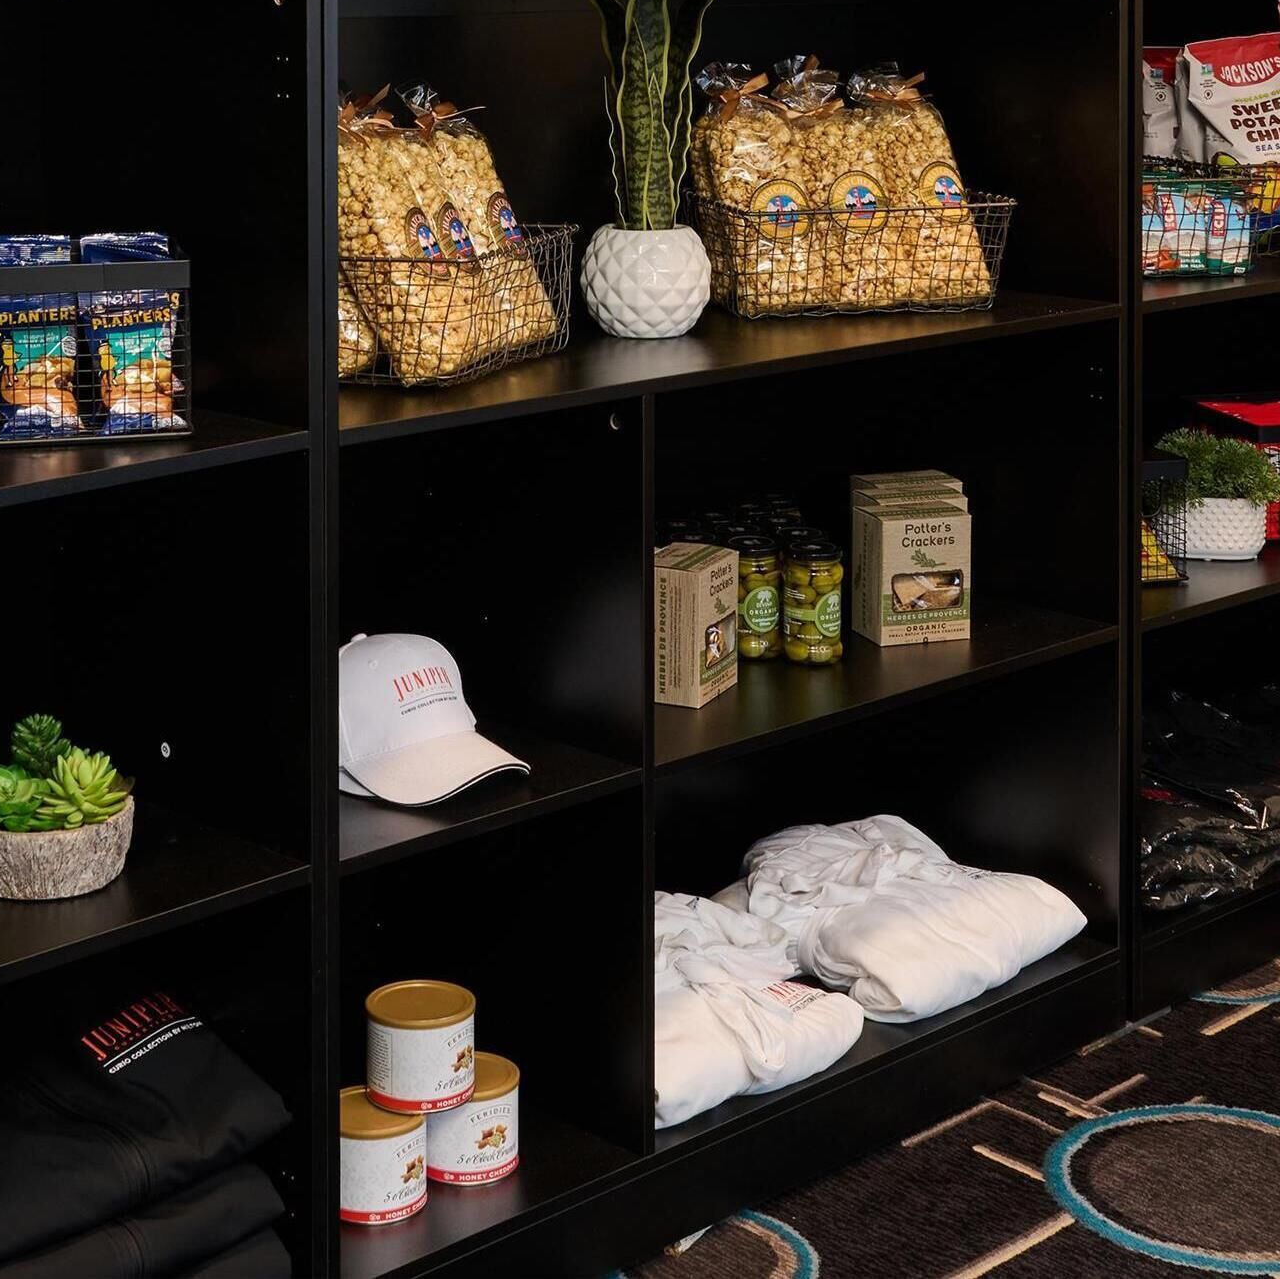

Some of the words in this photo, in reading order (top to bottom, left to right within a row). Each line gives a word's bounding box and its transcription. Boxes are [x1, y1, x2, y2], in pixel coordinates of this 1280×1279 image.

[1255, 143, 1273, 152] SEA
[91, 307, 172, 331] PLANTERS
[905, 521, 952, 535] Potter's
[901, 535, 956, 548] Crackers
[710, 563, 733, 584] Potter's
[709, 575, 734, 597] Crackers
[659, 576, 668, 637] PROVENCE
[887, 613, 916, 621] HERBES
[917, 612, 927, 620] DE
[929, 609, 968, 619] PROVENCE
[905, 622, 947, 633] ORGANIC
[392, 666, 453, 703] JUNIPER
[81, 992, 188, 1061] JUNIPER
[108, 1058, 132, 1074] CURIO
[131, 1032, 174, 1060] COLLECTION
[436, 1096, 459, 1109] HONEY
[469, 1107, 512, 1124] FERIDIES
[458, 1171, 488, 1182] HONEY
[385, 1205, 412, 1220] HONEY
